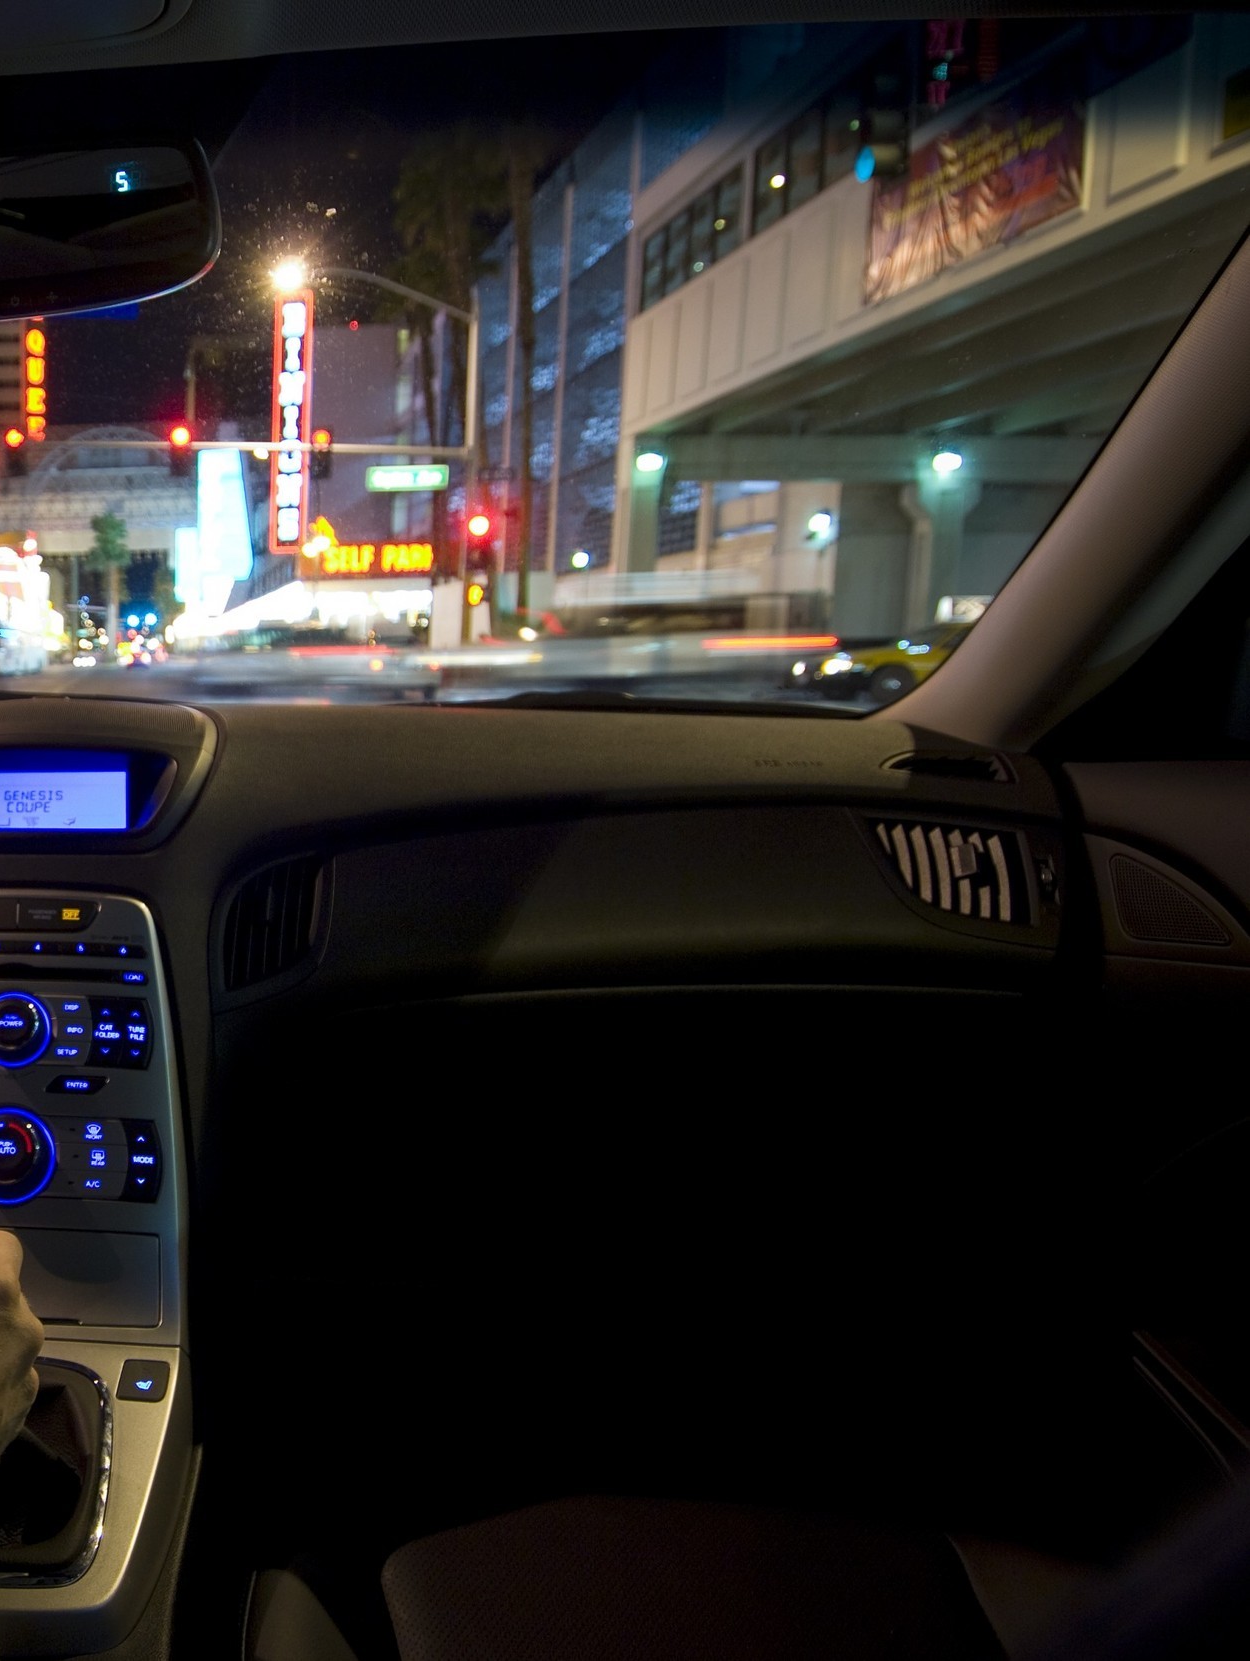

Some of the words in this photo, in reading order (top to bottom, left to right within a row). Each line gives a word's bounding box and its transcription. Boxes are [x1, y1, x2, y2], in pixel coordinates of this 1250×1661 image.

[323, 544, 375, 574] SELF
[3, 790, 64, 801] GENESIS
[6, 801, 51, 813] COUPE
[34, 943, 41, 951] 4
[66, 1026, 84, 1034] INFO
[95, 1031, 120, 1039] FOLDER
[129, 1033, 145, 1041] FILE
[56, 1048, 78, 1056] SETUP
[66, 1081, 88, 1089] ENTER
[132, 1156, 154, 1165] MODE
[85, 1180, 101, 1188] A/C
